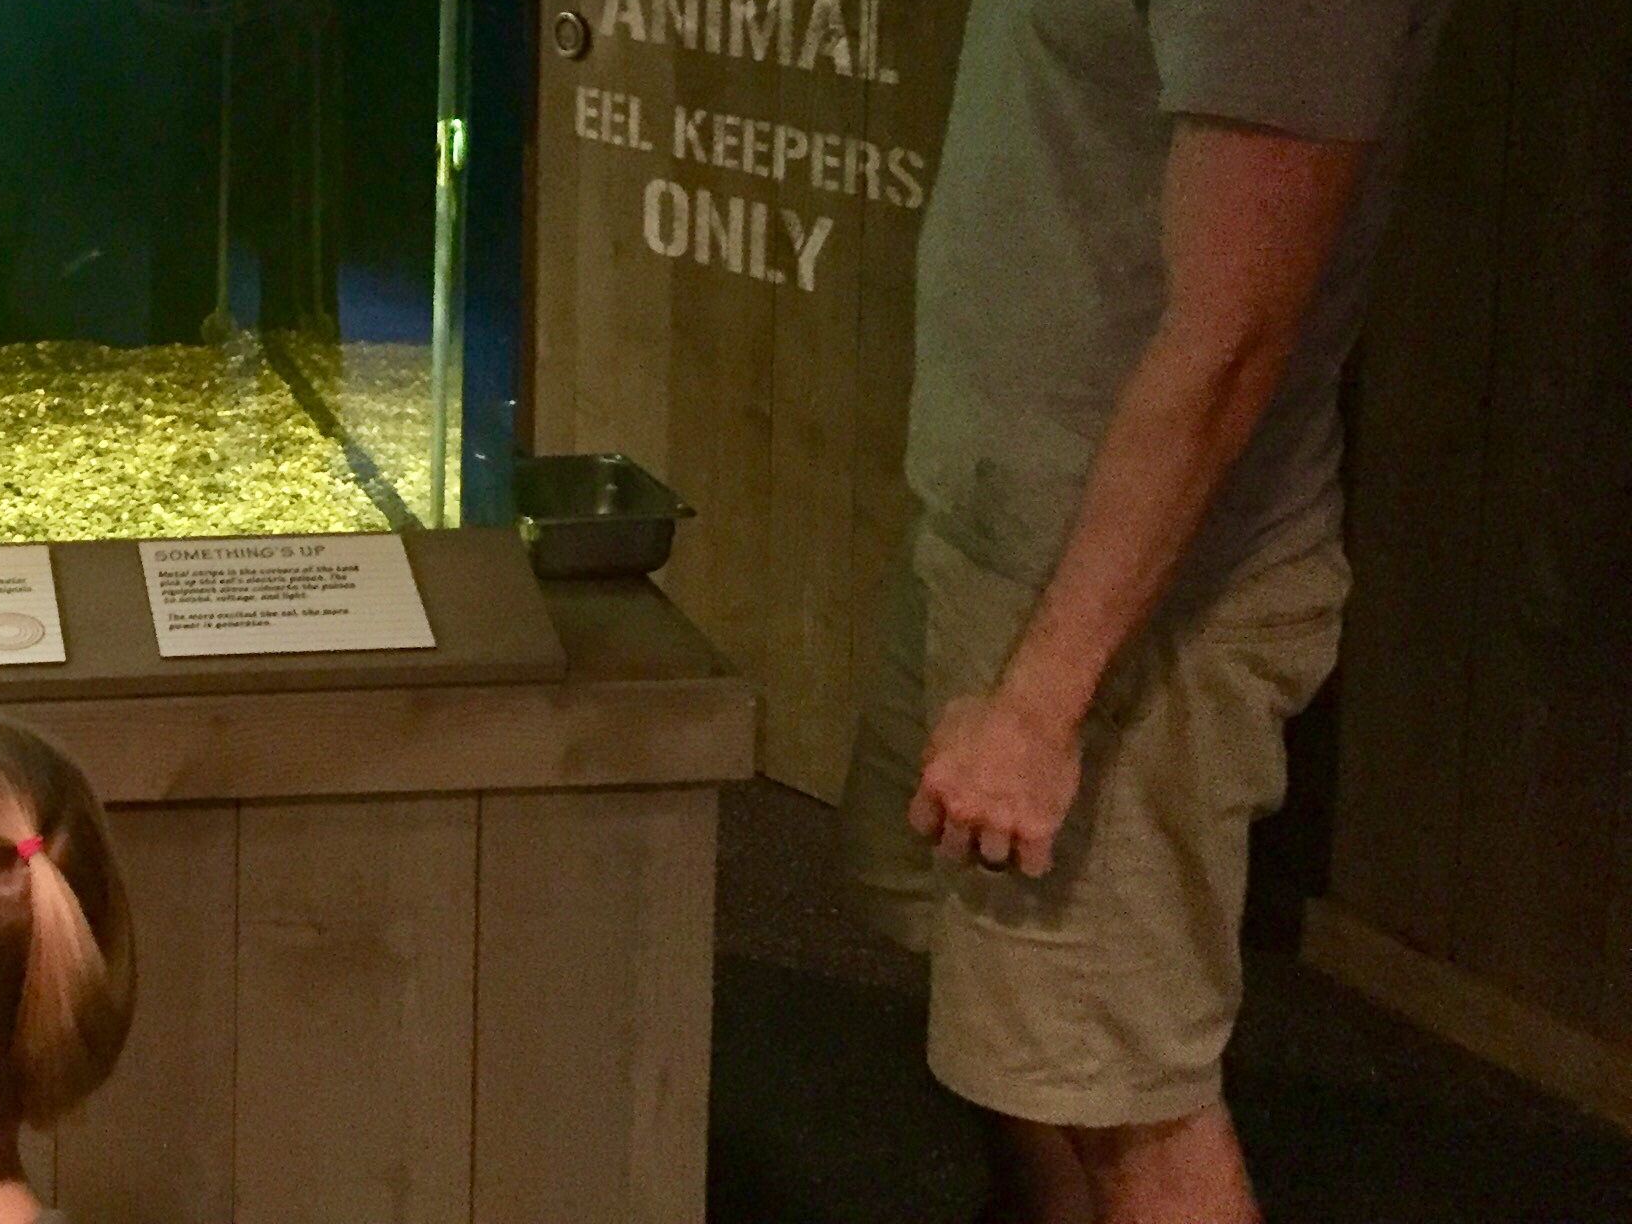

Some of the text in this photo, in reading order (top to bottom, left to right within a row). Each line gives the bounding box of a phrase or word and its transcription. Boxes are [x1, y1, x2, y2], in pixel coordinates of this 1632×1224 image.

[575, 86, 925, 209] EEL KEEPERS
[644, 178, 833, 292] ONLY
[154, 545, 326, 561] SOMETHING'S UP
